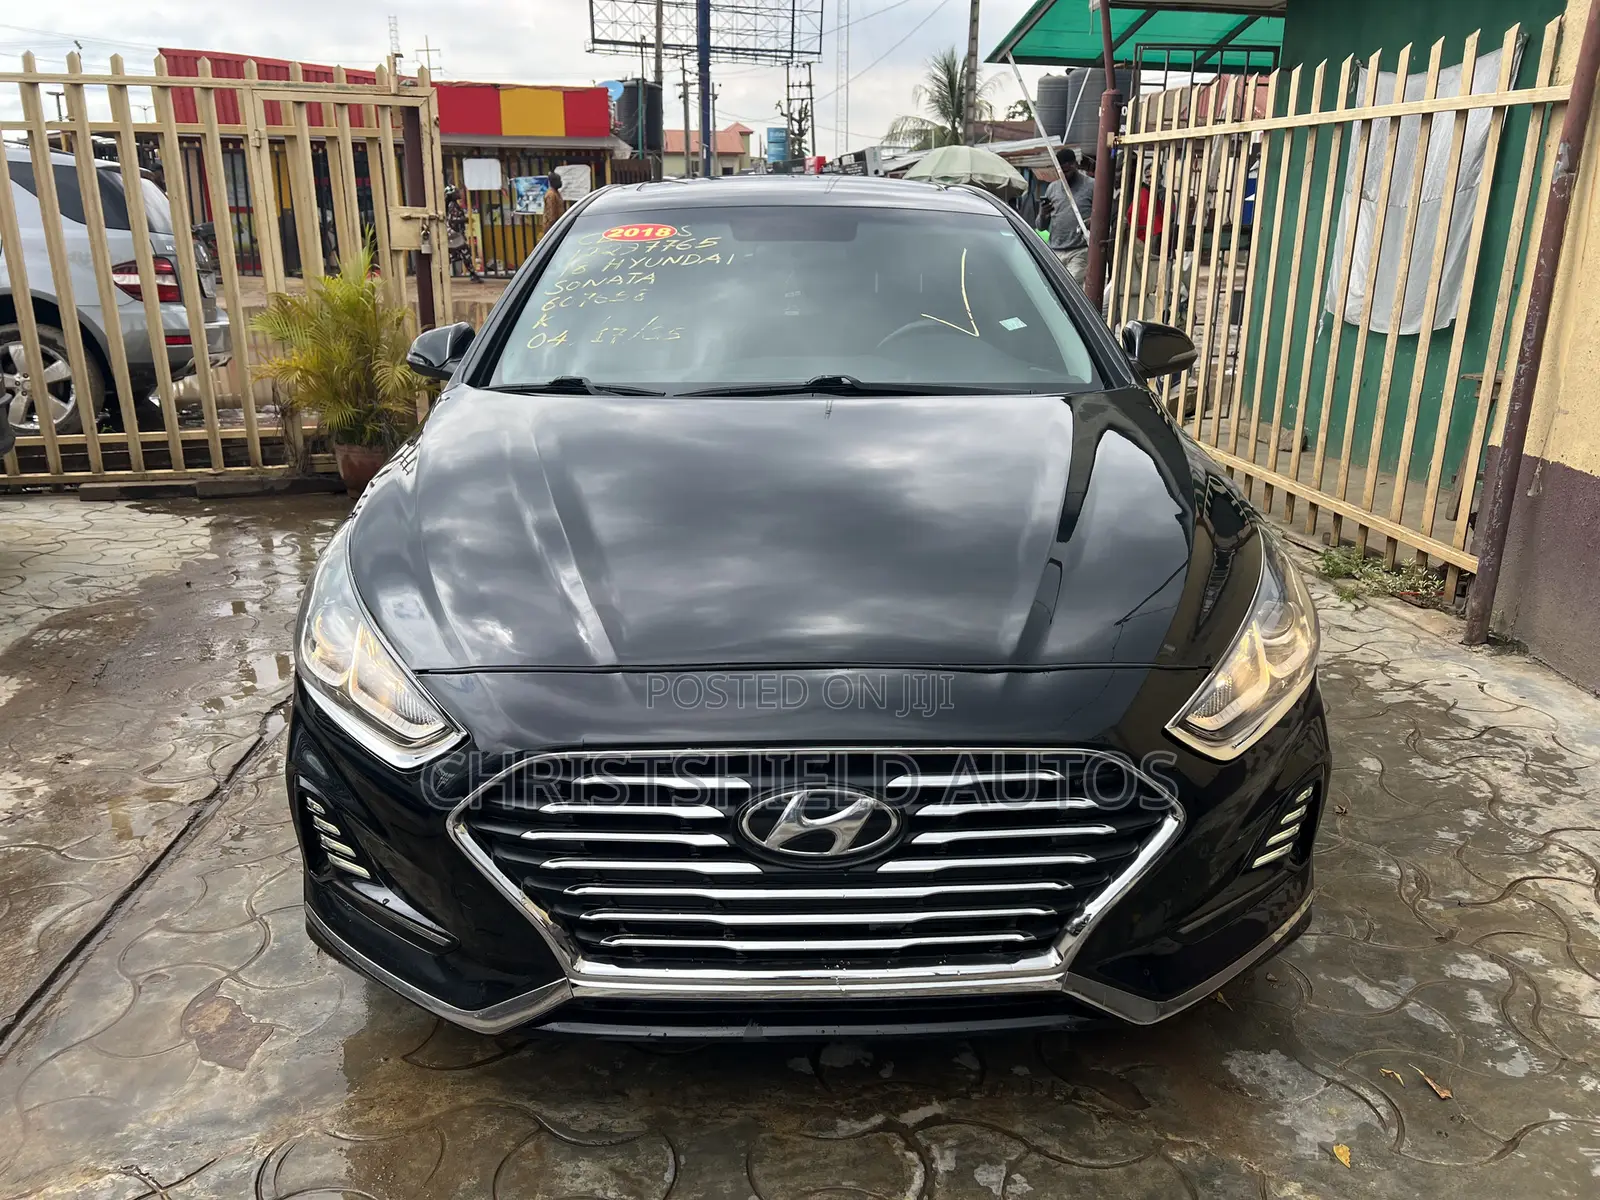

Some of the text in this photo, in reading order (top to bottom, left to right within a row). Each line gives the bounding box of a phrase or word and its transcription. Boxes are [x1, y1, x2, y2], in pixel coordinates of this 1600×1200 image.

[606, 226, 673, 239] 2018
[601, 252, 735, 274] HYUNDAI
[543, 271, 656, 296] SONATA
